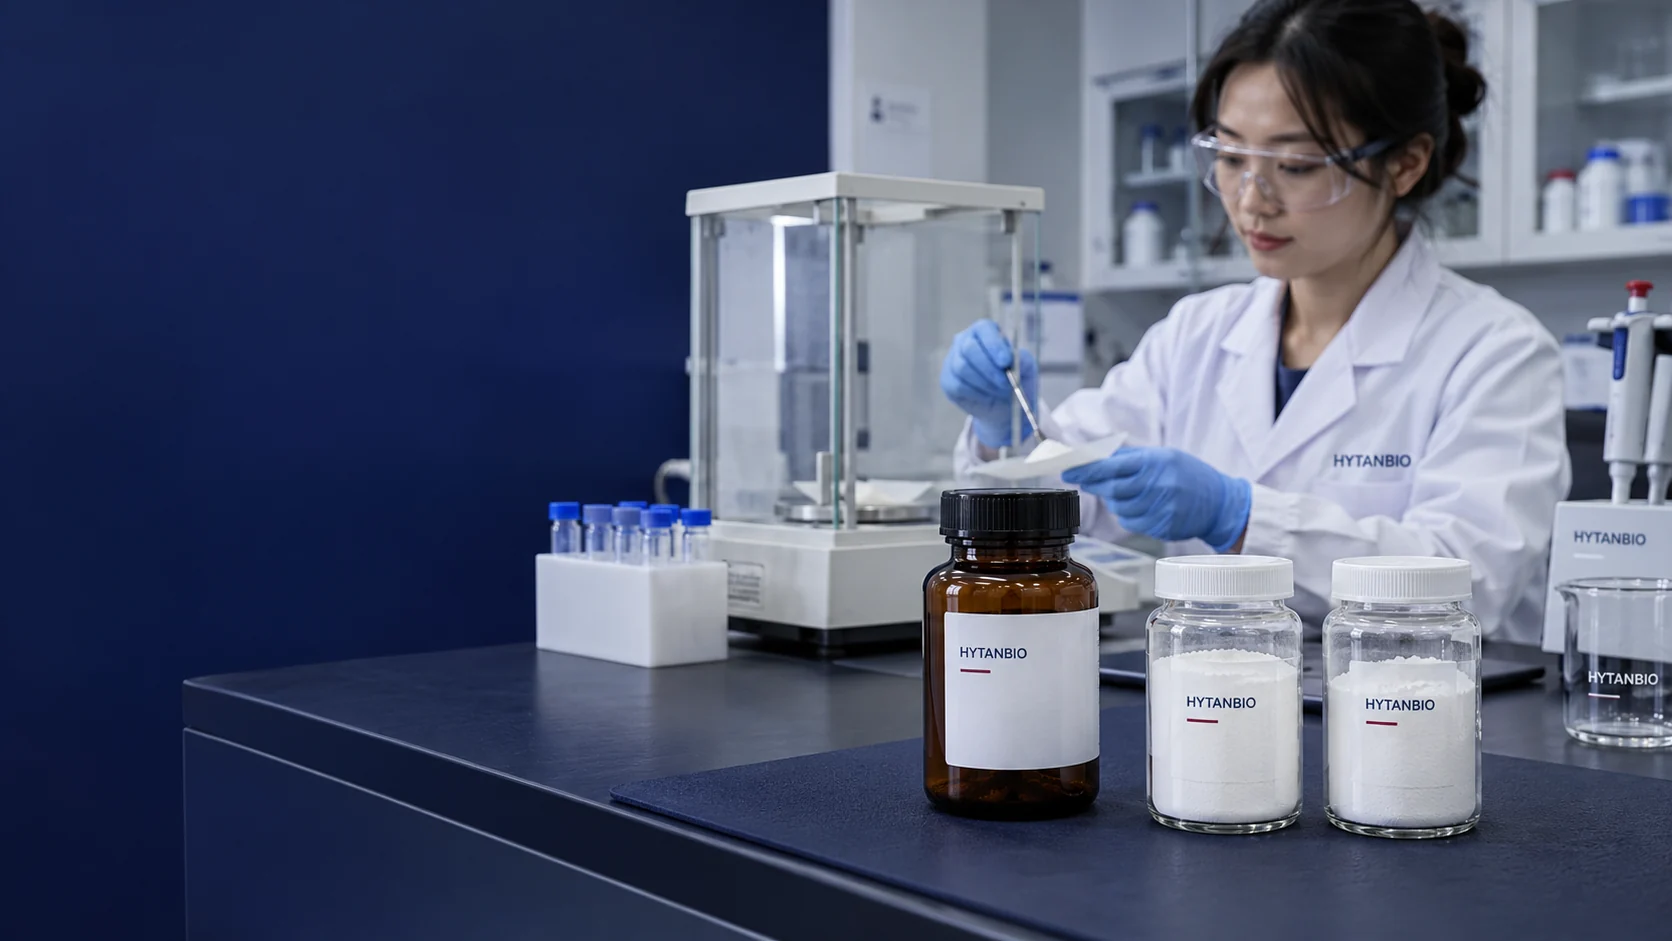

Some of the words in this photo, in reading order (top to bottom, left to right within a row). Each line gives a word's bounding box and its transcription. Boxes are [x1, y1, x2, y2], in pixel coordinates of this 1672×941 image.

[1333, 454, 1412, 468] HYTANBIO
[1574, 531, 1647, 546] HYTANBIO
[959, 646, 1028, 660] HYTANBIO
[1588, 671, 1659, 686] HYTANBIO
[1186, 696, 1257, 710] HYTANBIO
[1366, 698, 1436, 712] HYTANBIO
